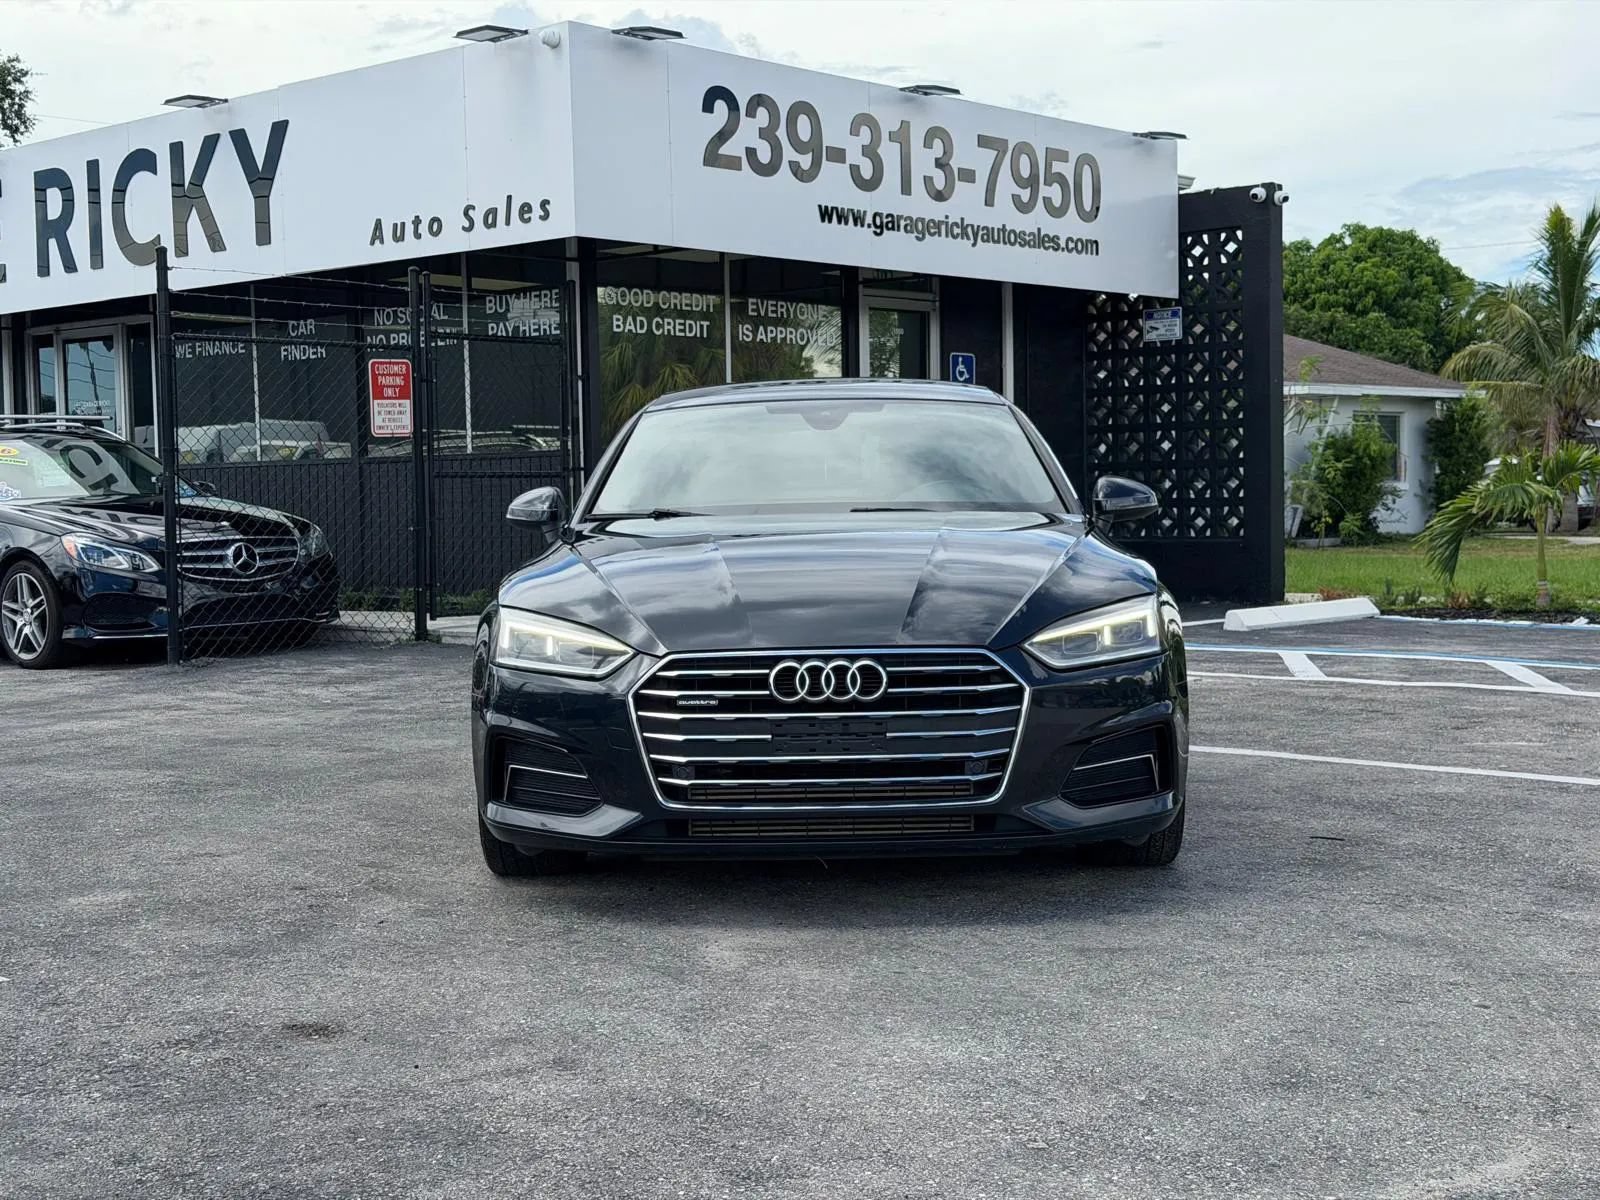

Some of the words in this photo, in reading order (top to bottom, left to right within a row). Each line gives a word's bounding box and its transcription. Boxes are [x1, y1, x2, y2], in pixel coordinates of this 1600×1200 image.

[701, 85, 1101, 224] 239-313-7950
[33, 119, 290, 278] RICKY
[369, 215, 443, 246] Auto
[462, 194, 551, 233] Sales
[817, 203, 1100, 257] www.garagerickyautosales.com
[486, 294, 516, 315] BUY
[519, 289, 560, 310] HERE
[604, 286, 653, 308] GOOD
[658, 289, 717, 313] CREDIT
[748, 298, 829, 321] EVERYONE
[373, 307, 394, 327] NO
[488, 321, 515, 337] PAY
[519, 318, 561, 337] HERE
[612, 314, 648, 334] BAD
[652, 317, 711, 338] CREDIT
[288, 319, 316, 337] CAR
[738, 324, 753, 342] IS
[757, 326, 836, 347] APPROVED
[175, 343, 193, 359] WE
[195, 340, 246, 357] FINANCE
[280, 345, 326, 361] FINDER
[366, 335, 387, 352] NO
[374, 364, 407, 375] CUSTOMER
[377, 376, 405, 386] PARKING
[383, 387, 400, 398] ONLY
